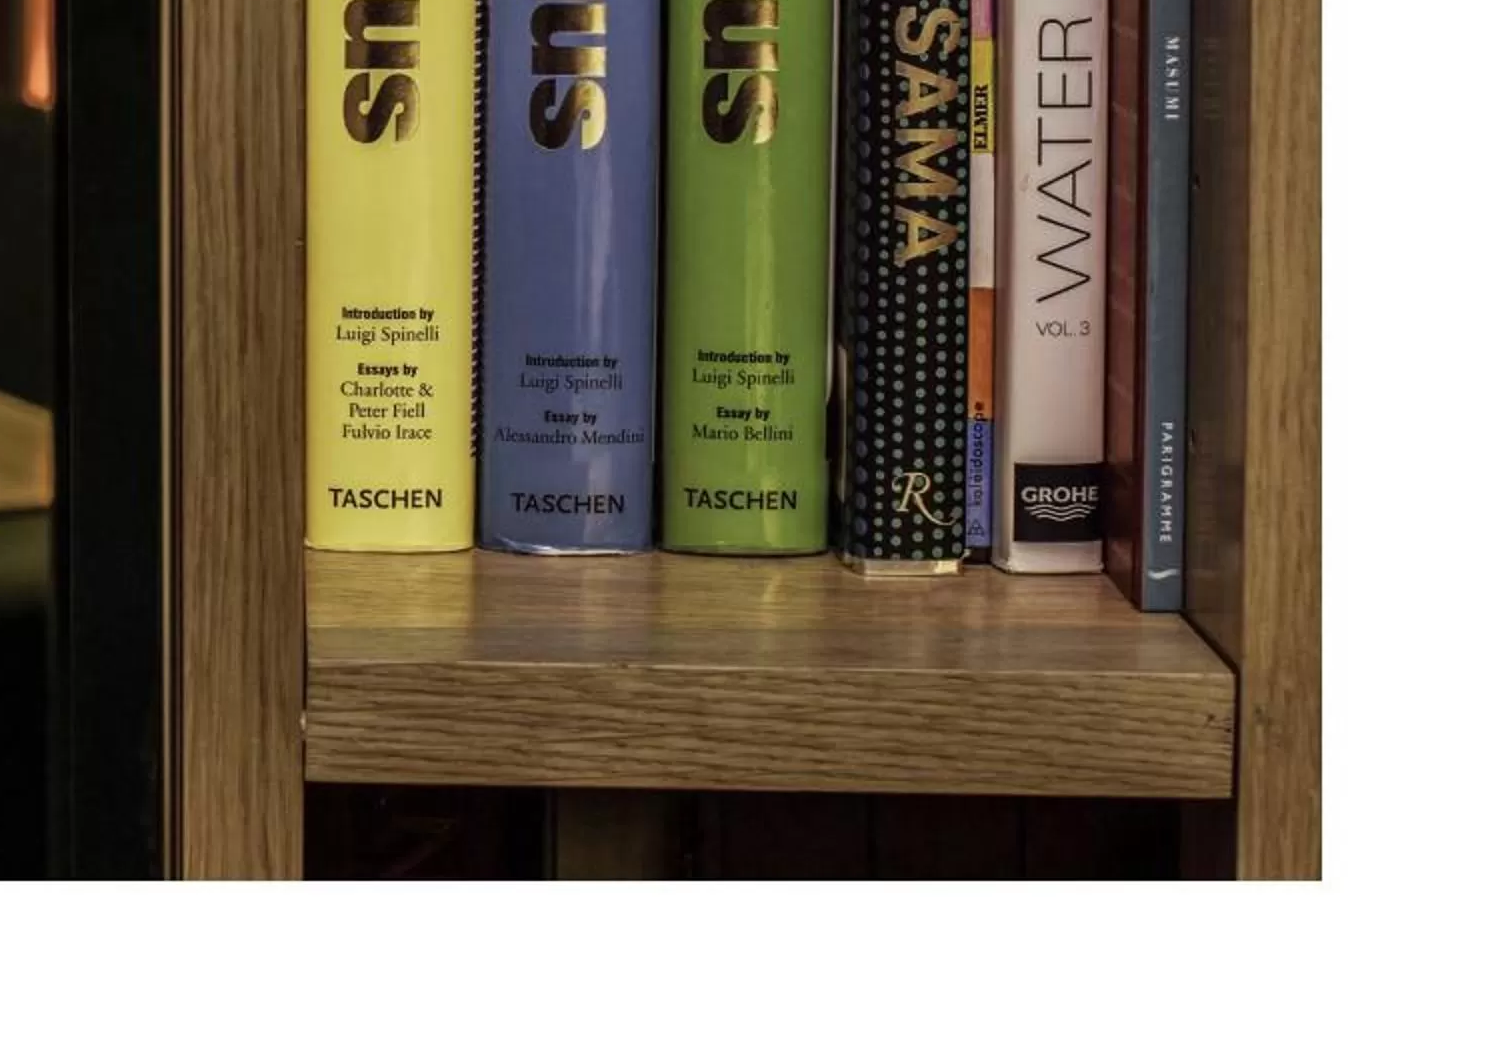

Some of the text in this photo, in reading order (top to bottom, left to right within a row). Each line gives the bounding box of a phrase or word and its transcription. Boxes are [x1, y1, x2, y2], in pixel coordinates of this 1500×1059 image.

[1164, 34, 1180, 121] MASUMI
[974, 84, 989, 151] ELMER
[1036, 16, 1093, 304] WATER
[341, 307, 434, 323] Introduction by
[335, 325, 440, 346] Luigi Spinelli
[1035, 320, 1091, 338] VOL. 3
[525, 354, 618, 371] Introduction by
[697, 350, 790, 366] Introduction by
[357, 363, 418, 379] Essays by
[692, 368, 795, 388] Luigi Spinelli
[340, 381, 434, 398] Charlotte &
[519, 372, 623, 393] Luigi Spinelli
[349, 402, 426, 419] Peter Fiell
[544, 410, 597, 426] Essay by
[716, 406, 770, 422] Essay by
[342, 423, 433, 440] Fulvio Irace
[494, 428, 644, 445] Alessandro Mendini
[692, 424, 794, 441] Mario Bellini
[970, 401, 988, 509] kaleidoscope
[1158, 420, 1174, 545] PARIGRAMME
[329, 488, 443, 509] TASCHEN
[511, 492, 625, 515] TASCHEN
[684, 488, 798, 510] TASCHEN
[891, 472, 957, 526] R
[1020, 486, 1099, 503] GROHE
